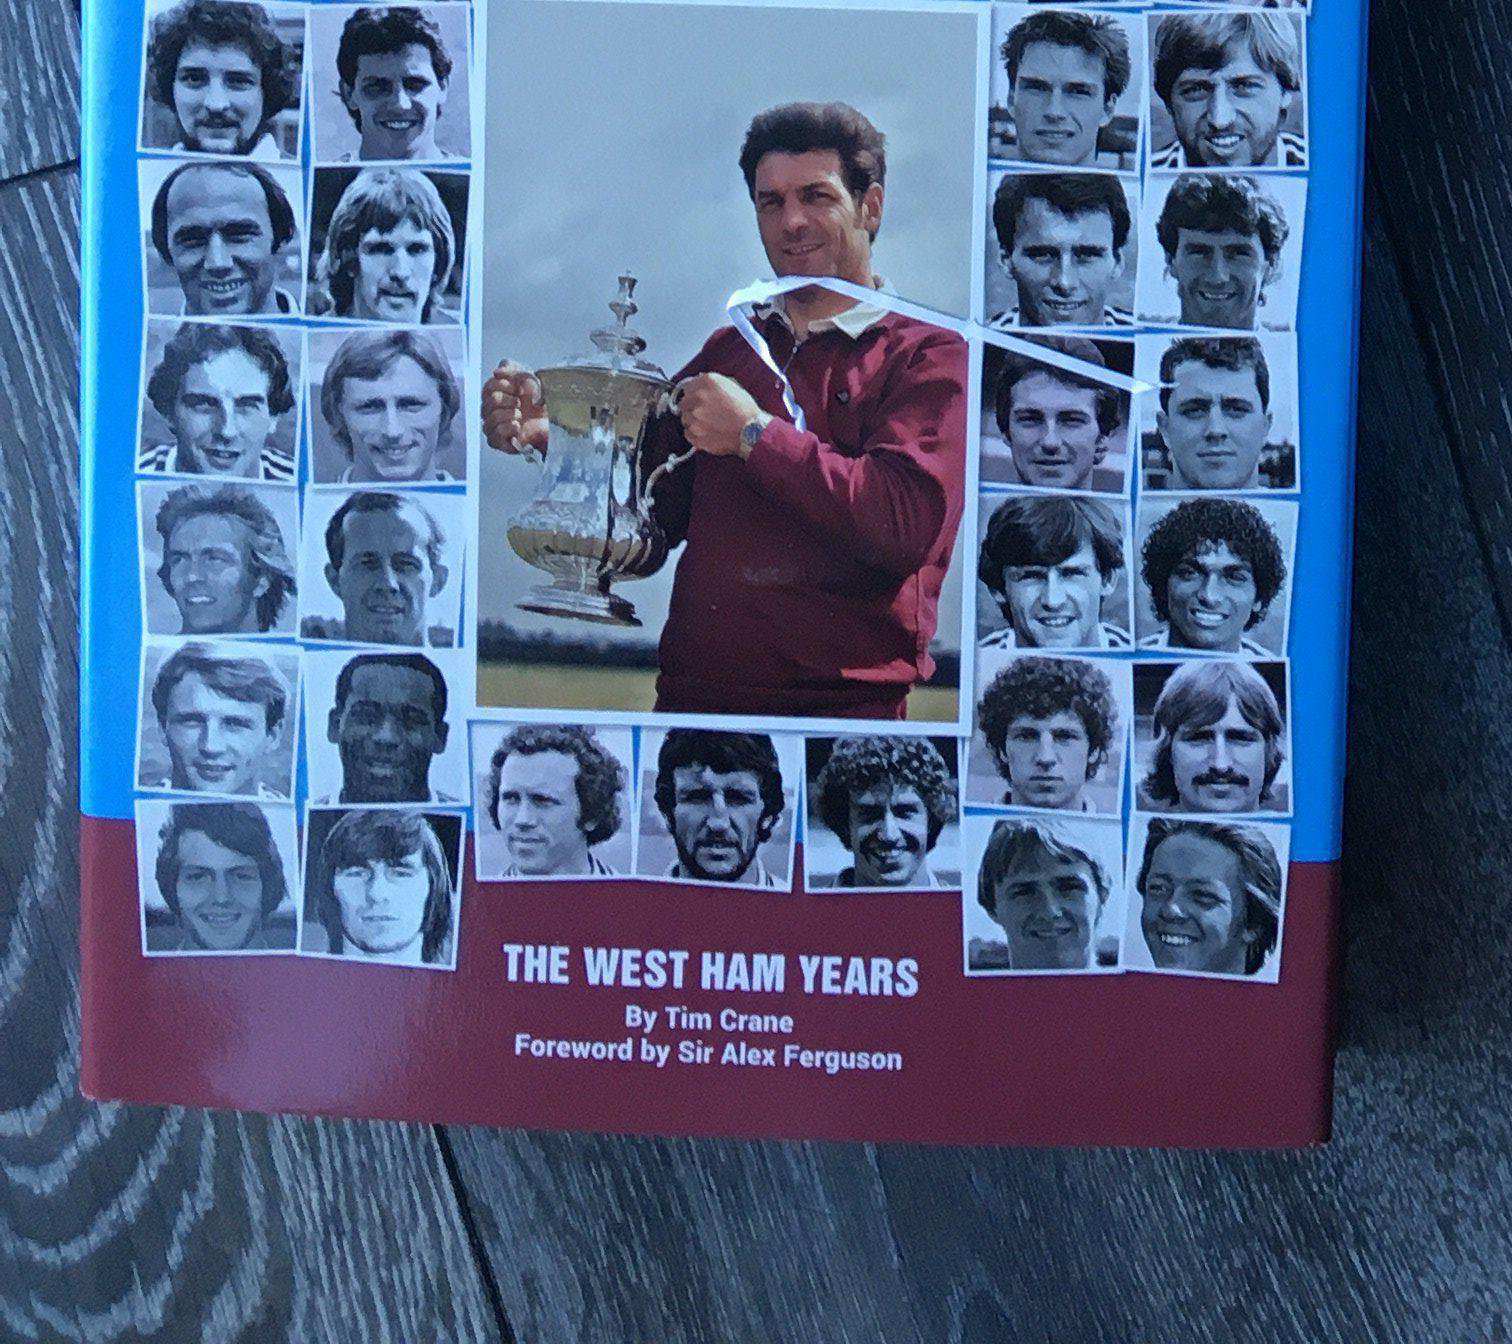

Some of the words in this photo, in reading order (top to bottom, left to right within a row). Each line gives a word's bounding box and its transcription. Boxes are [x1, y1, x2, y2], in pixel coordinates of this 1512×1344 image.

[503, 943, 570, 985] THE
[583, 946, 690, 989] WEST
[701, 951, 786, 993] HAM
[798, 954, 919, 997] YEARS
[625, 1004, 658, 1034] By
[664, 1005, 712, 1031] Tim
[719, 1008, 794, 1034] Crane
[514, 1032, 633, 1061] Foreword
[640, 1037, 671, 1068] by
[677, 1039, 715, 1064] Sir
[720, 1041, 776, 1067] Alex
[783, 1043, 903, 1075] Ferguson
